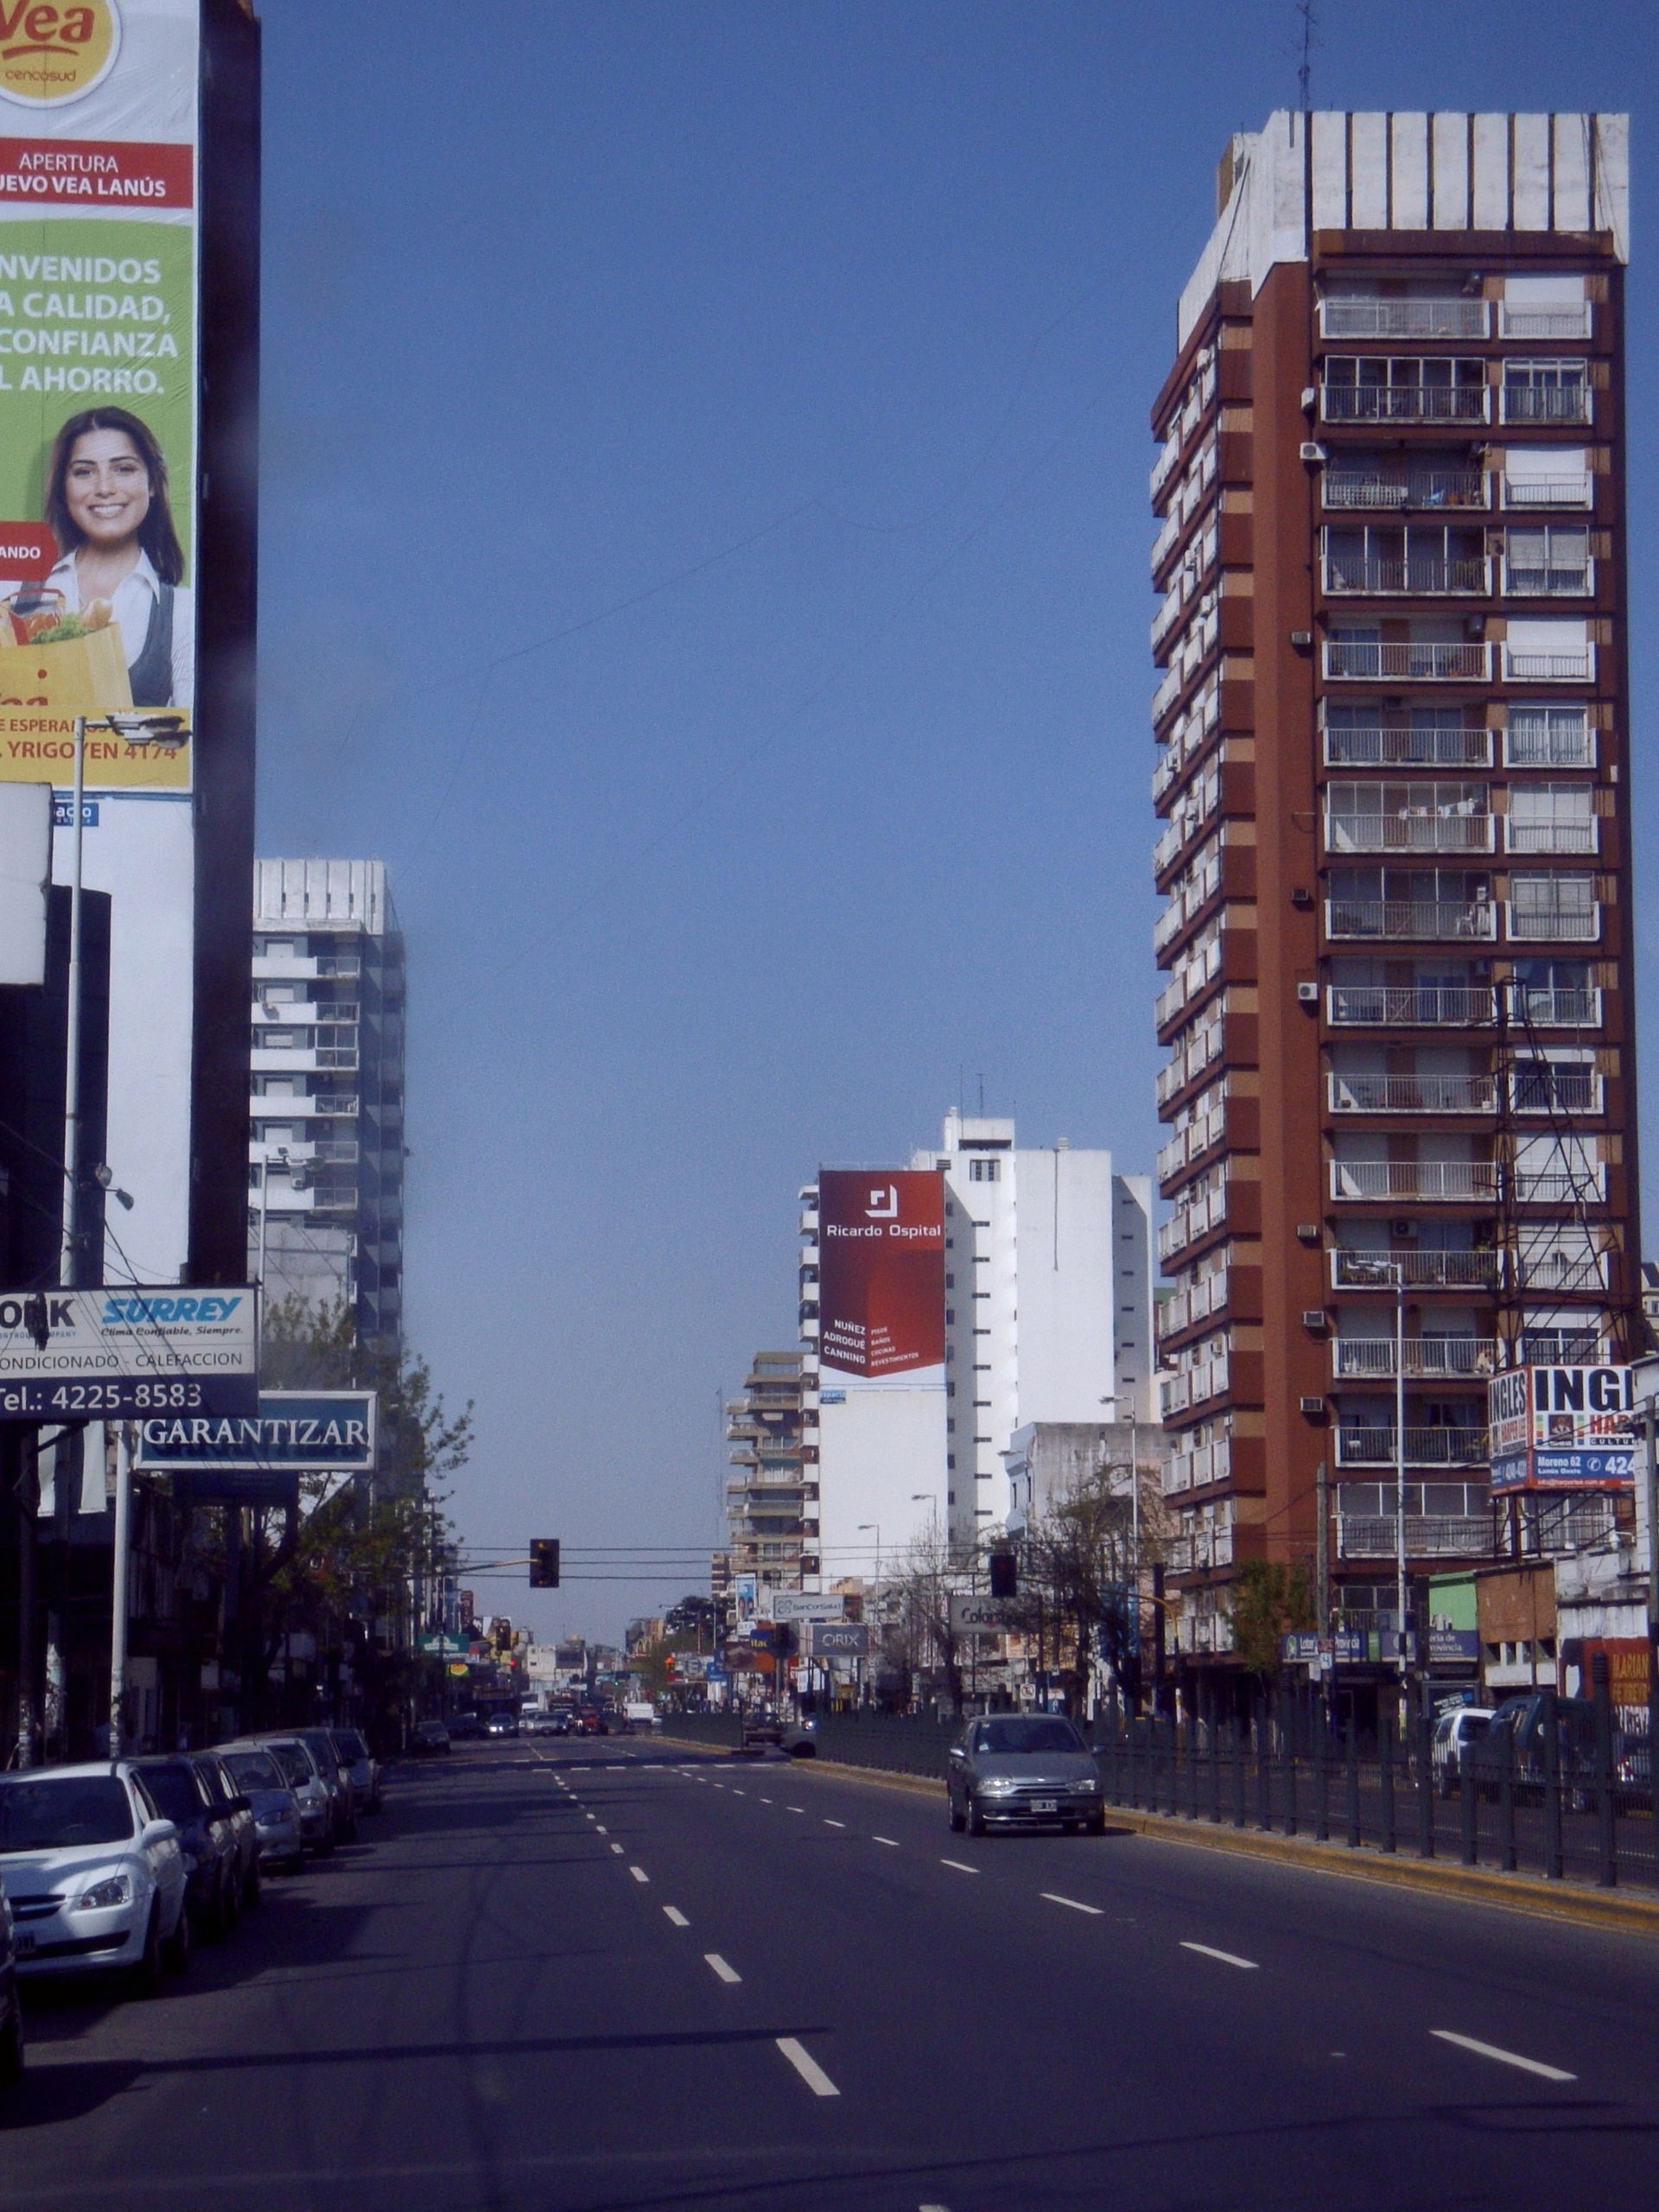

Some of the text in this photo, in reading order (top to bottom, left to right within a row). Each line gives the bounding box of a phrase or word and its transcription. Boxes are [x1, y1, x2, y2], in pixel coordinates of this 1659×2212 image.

[5, 69, 76, 82] cencosud
[19, 153, 118, 173] APERTURA
[52, 176, 92, 194] VEA
[98, 176, 166, 197] LANÚS
[22, 292, 170, 326] CALIDAD,
[21, 366, 165, 395] AHORRO.
[827, 1224, 941, 1239] Ricardo Ospital
[102, 1297, 243, 1323] SURREY
[101, 1325, 244, 1338] Clima Confiable, Siempre.
[834, 1319, 866, 1336] NUÑEZ
[136, 1353, 242, 1367] CALEFACCION
[823, 1345, 866, 1364] CANNING
[52, 1383, 202, 1410] 4225-8583
[1489, 1372, 1526, 1425] INGLES
[143, 1419, 369, 1446] GARANTIZAR
[1538, 1456, 1581, 1467] Moreno 62
[822, 1633, 859, 1647] ORIX
[1429, 1643, 1462, 1652] rovincia
